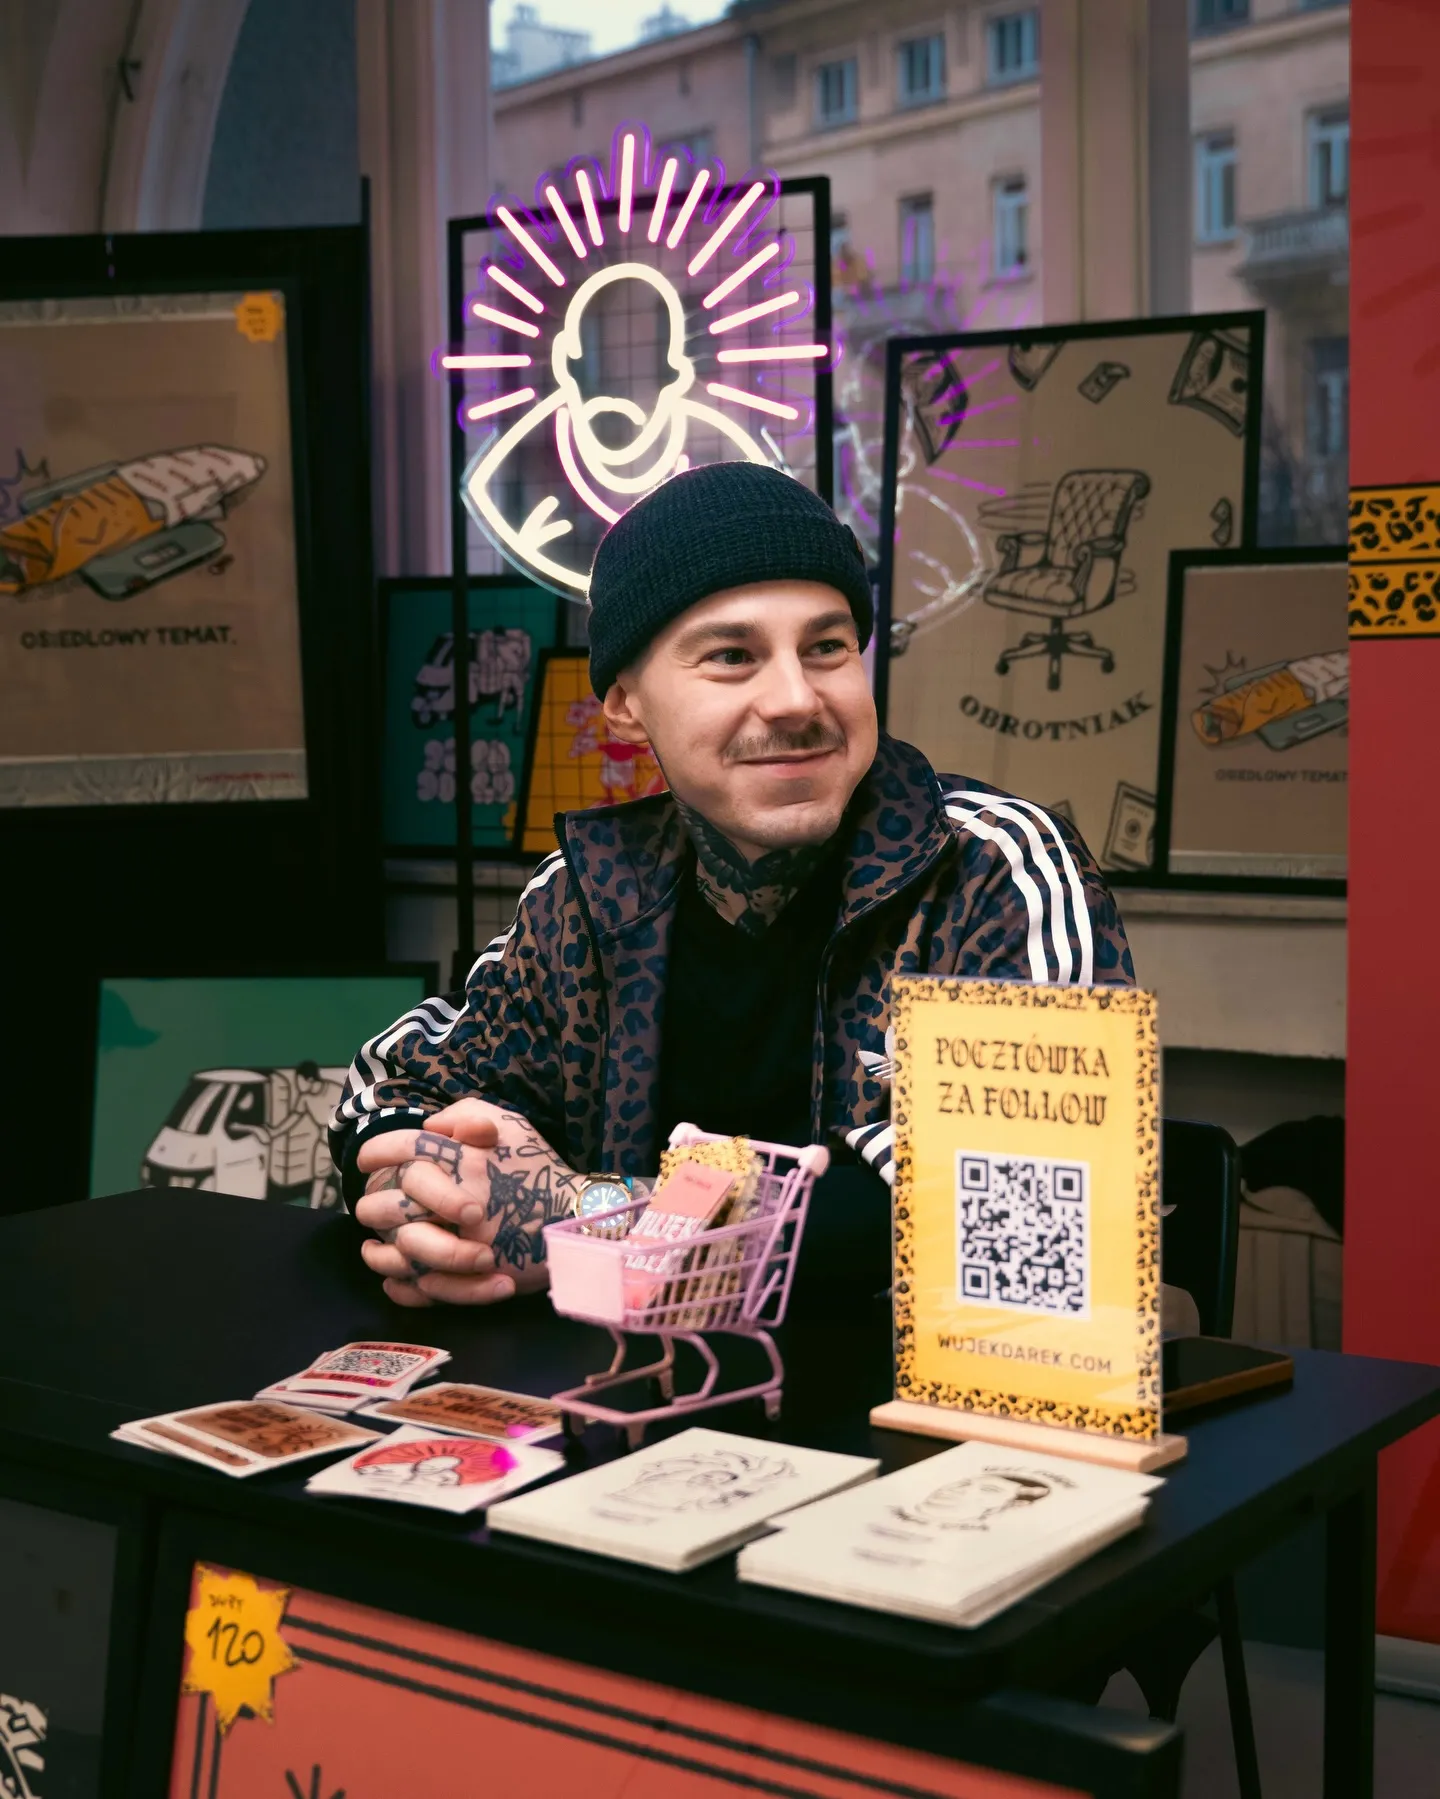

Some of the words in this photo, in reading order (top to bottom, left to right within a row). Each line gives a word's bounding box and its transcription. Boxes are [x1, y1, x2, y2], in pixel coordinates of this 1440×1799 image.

[959, 690, 1153, 741] OBROTNIAK
[935, 1033, 1110, 1078] POCZTÓWKA
[937, 1081, 975, 1115] ZA
[983, 1086, 1108, 1126] FOLLOW
[937, 1333, 1113, 1374] WUJEKDAREK.COM
[206, 1616, 265, 1667] 120
